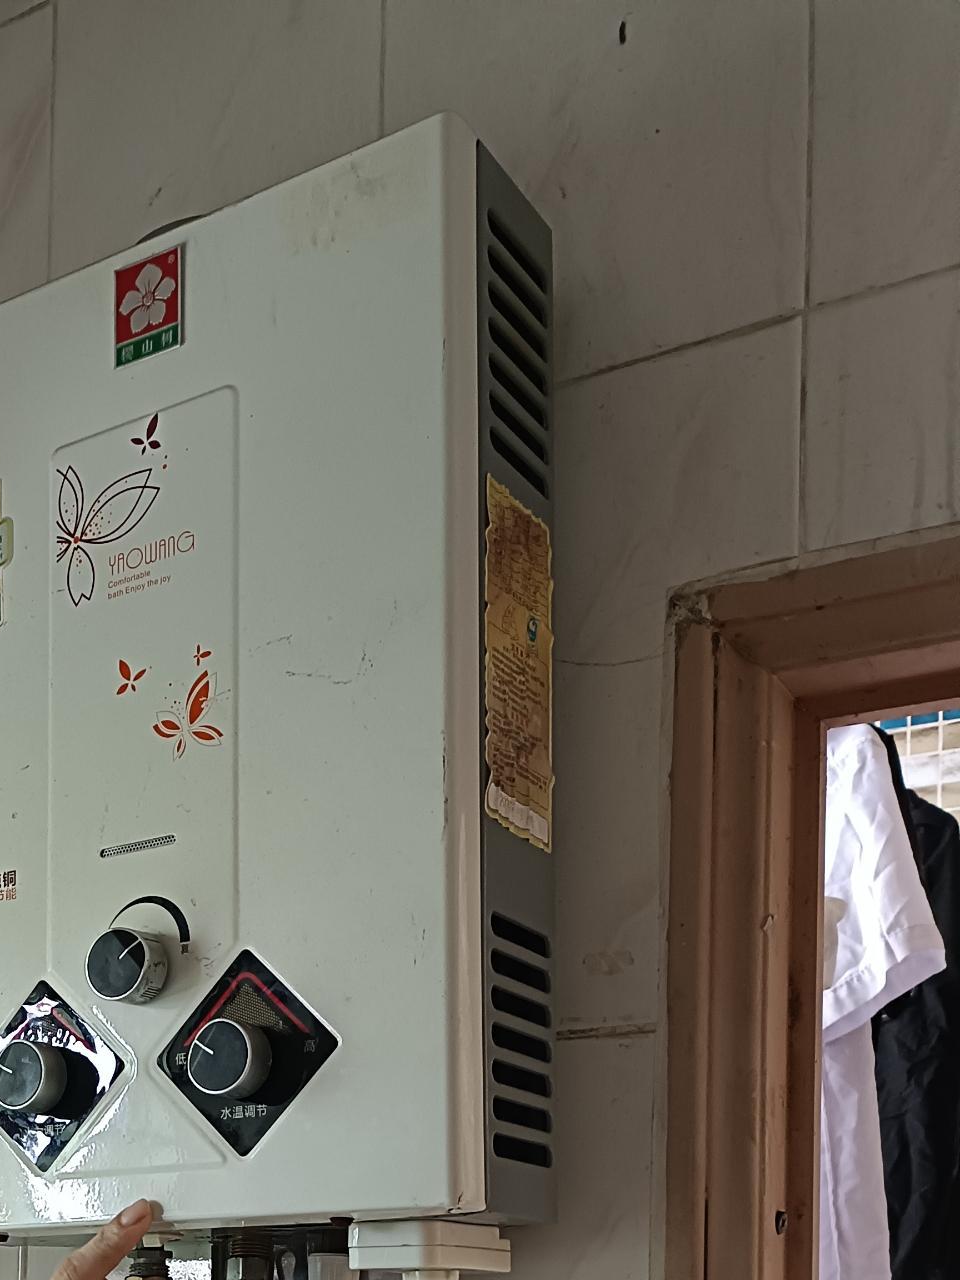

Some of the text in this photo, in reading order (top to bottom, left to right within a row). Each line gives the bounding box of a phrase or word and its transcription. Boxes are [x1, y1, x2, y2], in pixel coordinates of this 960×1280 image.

[108, 530, 195, 576] YAOWANG
[107, 570, 151, 588] Comfortable
[107, 574, 172, 600] bath Enjoy the joy
[304, 1039, 316, 1053] 高
[175, 1052, 187, 1066] 低
[220, 1103, 268, 1120] 水温调节
